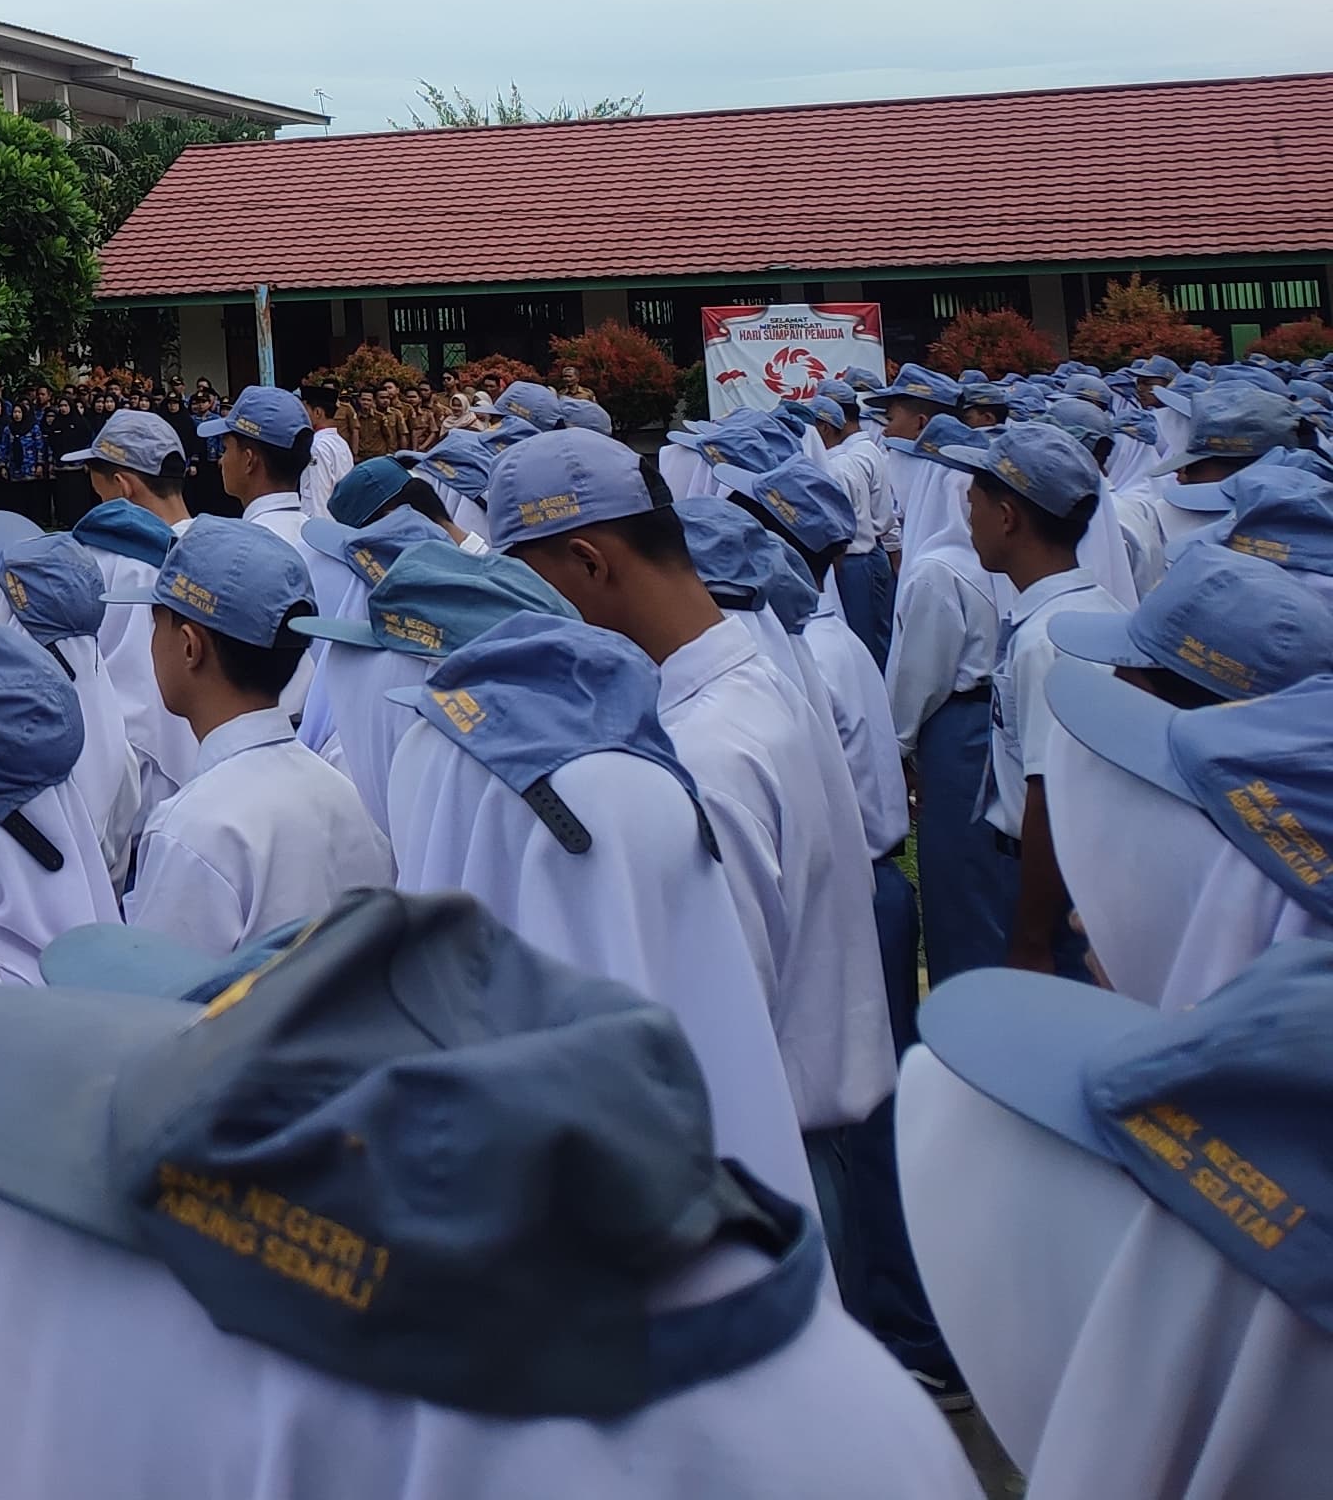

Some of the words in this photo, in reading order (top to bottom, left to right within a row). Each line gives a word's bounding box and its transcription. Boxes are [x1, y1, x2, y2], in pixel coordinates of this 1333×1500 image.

[739, 330, 762, 340] HARI
[763, 329, 803, 340] SUMPAH
[805, 328, 845, 340] PEMUDA
[1263, 830, 1324, 886] SELATAN
[1275, 811, 1329, 863] NEGERI
[1188, 1165, 1286, 1251] SELATAN
[1200, 1137, 1289, 1212] NEGERI
[1283, 1203, 1307, 1231] 1
[157, 1191, 257, 1258] ABUNG
[240, 1187, 367, 1269] NEGERI
[372, 1245, 390, 1283] 1
